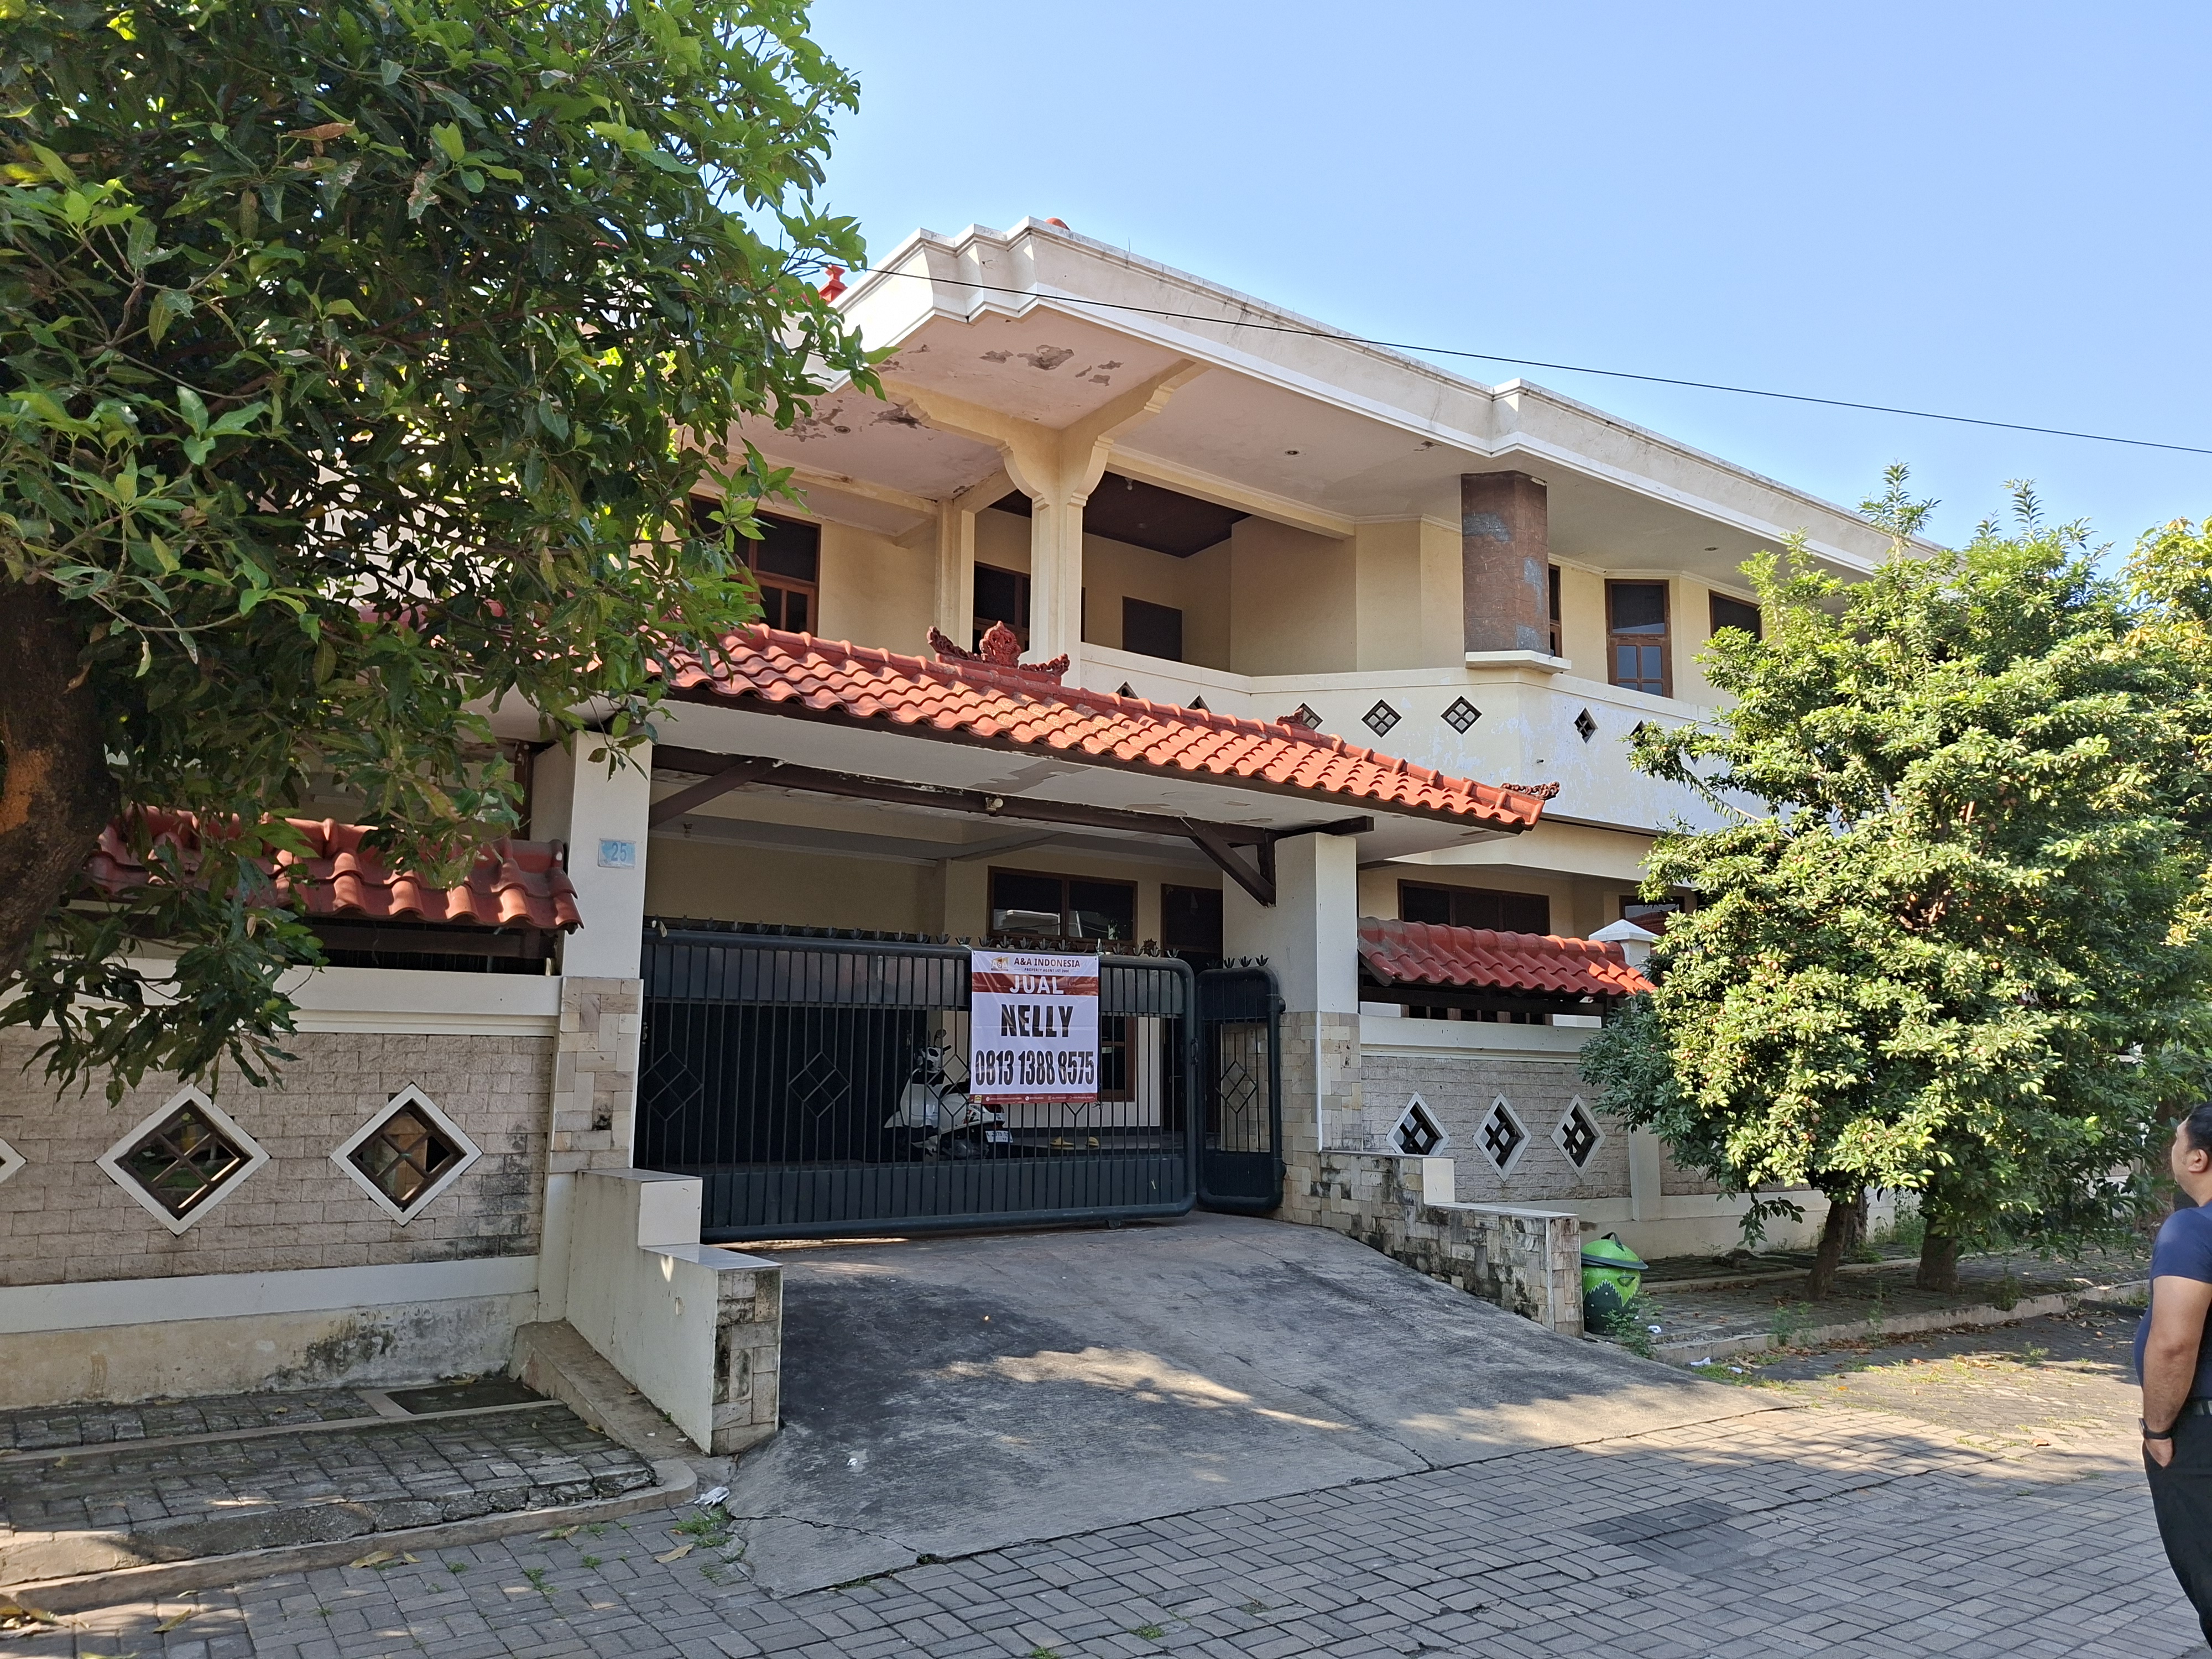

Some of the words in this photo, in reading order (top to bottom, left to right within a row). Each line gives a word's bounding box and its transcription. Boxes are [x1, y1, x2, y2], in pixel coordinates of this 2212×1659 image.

[611, 842, 627, 862] 25
[1014, 957, 1032, 966] A&A
[1034, 958, 1081, 968] INDONESIA
[1009, 974, 1064, 995] JUAL
[1001, 1004, 1073, 1037] NELLY
[975, 1050, 1014, 1086] 0813
[1018, 1050, 1055, 1086] 1388
[1058, 1051, 1094, 1085] 8575
